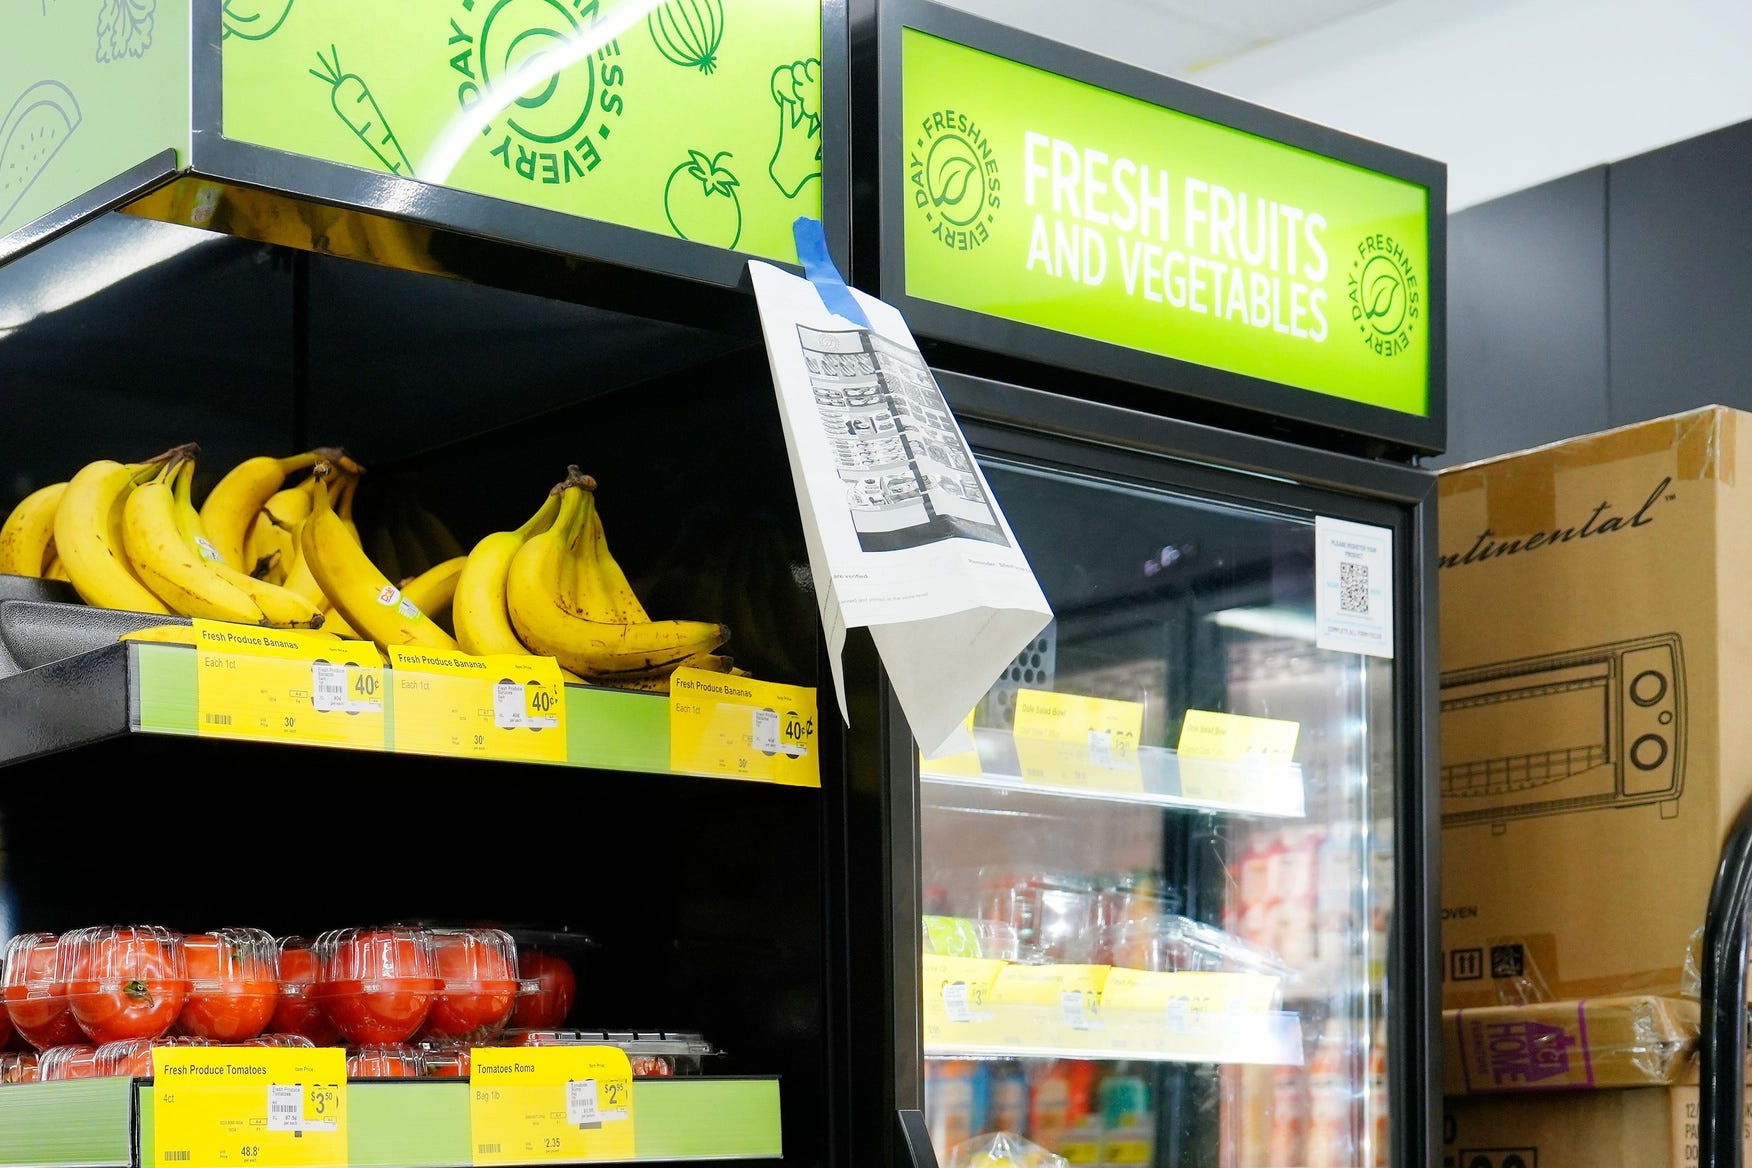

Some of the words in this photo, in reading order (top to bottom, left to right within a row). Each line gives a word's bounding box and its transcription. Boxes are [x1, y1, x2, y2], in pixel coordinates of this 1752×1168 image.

[448, 17, 485, 113] DAY
[490, 135, 602, 184] EVERY
[922, 110, 1001, 209] FRESHNESS
[911, 152, 929, 209] DAY
[1024, 130, 1170, 242] FRESH
[1185, 176, 1329, 283] FRUITS
[932, 221, 990, 251] EVERY
[1026, 213, 1108, 287] AND
[1117, 235, 1329, 343] VEGETABLES
[1358, 234, 1419, 318] FRESHNESS
[1348, 273, 1362, 321] DAY
[1365, 331, 1409, 356] EVERY
[202, 630, 226, 642] Fresh
[228, 633, 262, 646] Produce
[263, 637, 299, 650] Bananas
[204, 656, 224, 669] Each
[225, 658, 236, 669] 1ct
[398, 653, 421, 664] Fresh
[422, 655, 453, 667] Produce
[453, 658, 487, 669] Bananas
[401, 679, 418, 690] Each
[420, 680, 430, 690] 1ct
[676, 678, 695, 690] Fresh
[695, 681, 723, 694] Produce
[724, 685, 752, 698] Bananas
[676, 702, 691, 713] Each
[1487, 1020, 1530, 1086] HOME
[164, 1064, 188, 1075] Fresh
[189, 1064, 224, 1075] Produce
[226, 1064, 267, 1075] Tomatoes
[477, 1063, 512, 1074] Tomatoes
[514, 1063, 535, 1073] Roma
[163, 1093, 175, 1104] 4ct
[476, 1090, 490, 1101] Bag
[491, 1090, 501, 1100] 1lb
